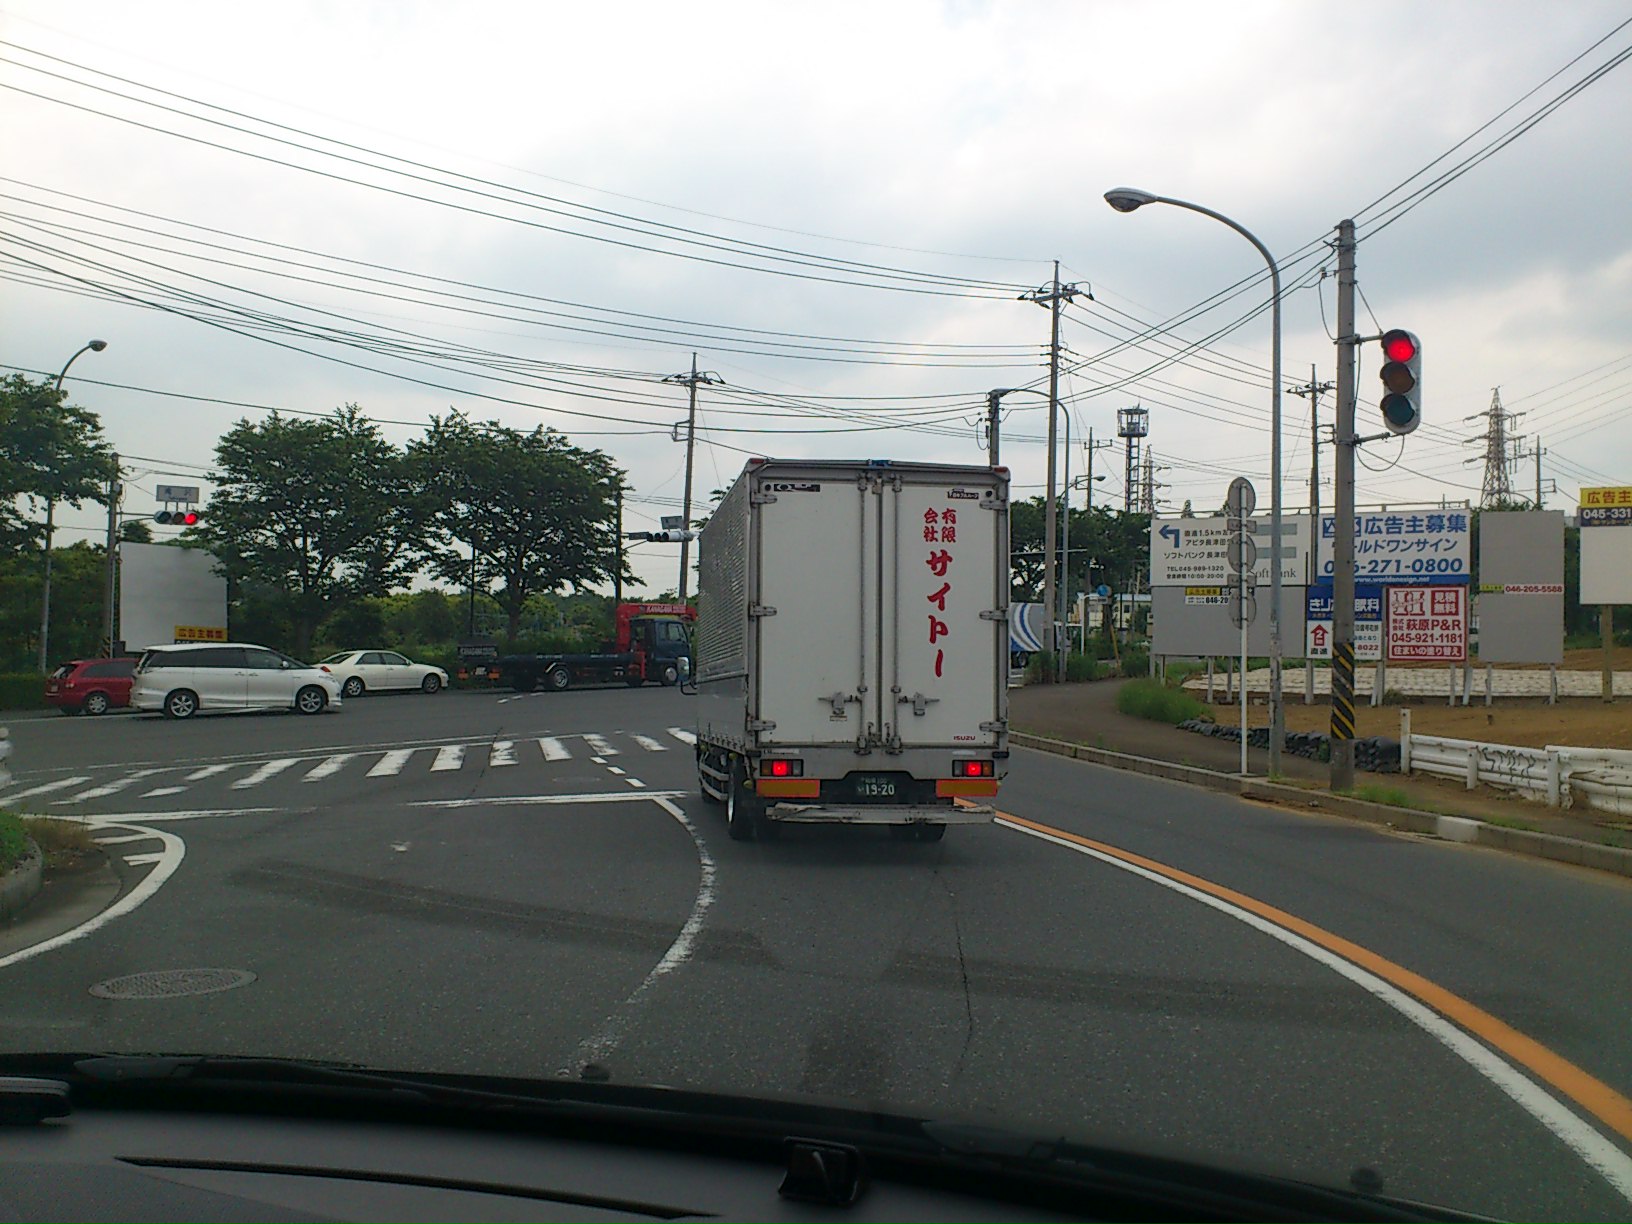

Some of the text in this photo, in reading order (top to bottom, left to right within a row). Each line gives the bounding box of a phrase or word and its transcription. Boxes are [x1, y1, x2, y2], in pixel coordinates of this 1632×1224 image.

[1587, 490, 1632, 504] 広告主
[1582, 508, 1632, 520] 045-331
[923, 507, 939, 543] 会社
[941, 507, 957, 543] 有限
[1364, 513, 1467, 535] 広告主募集
[1332, 538, 1458, 554] ルドワンサイン
[1254, 567, 1297, 578] oftnk
[1323, 557, 1463, 574] 0-271-0800
[1309, 598, 1380, 612] きり眼科
[925, 548, 953, 678] サイトー
[1391, 632, 1463, 643] 045-921-1181
[866, 784, 895, 796] 19-20
